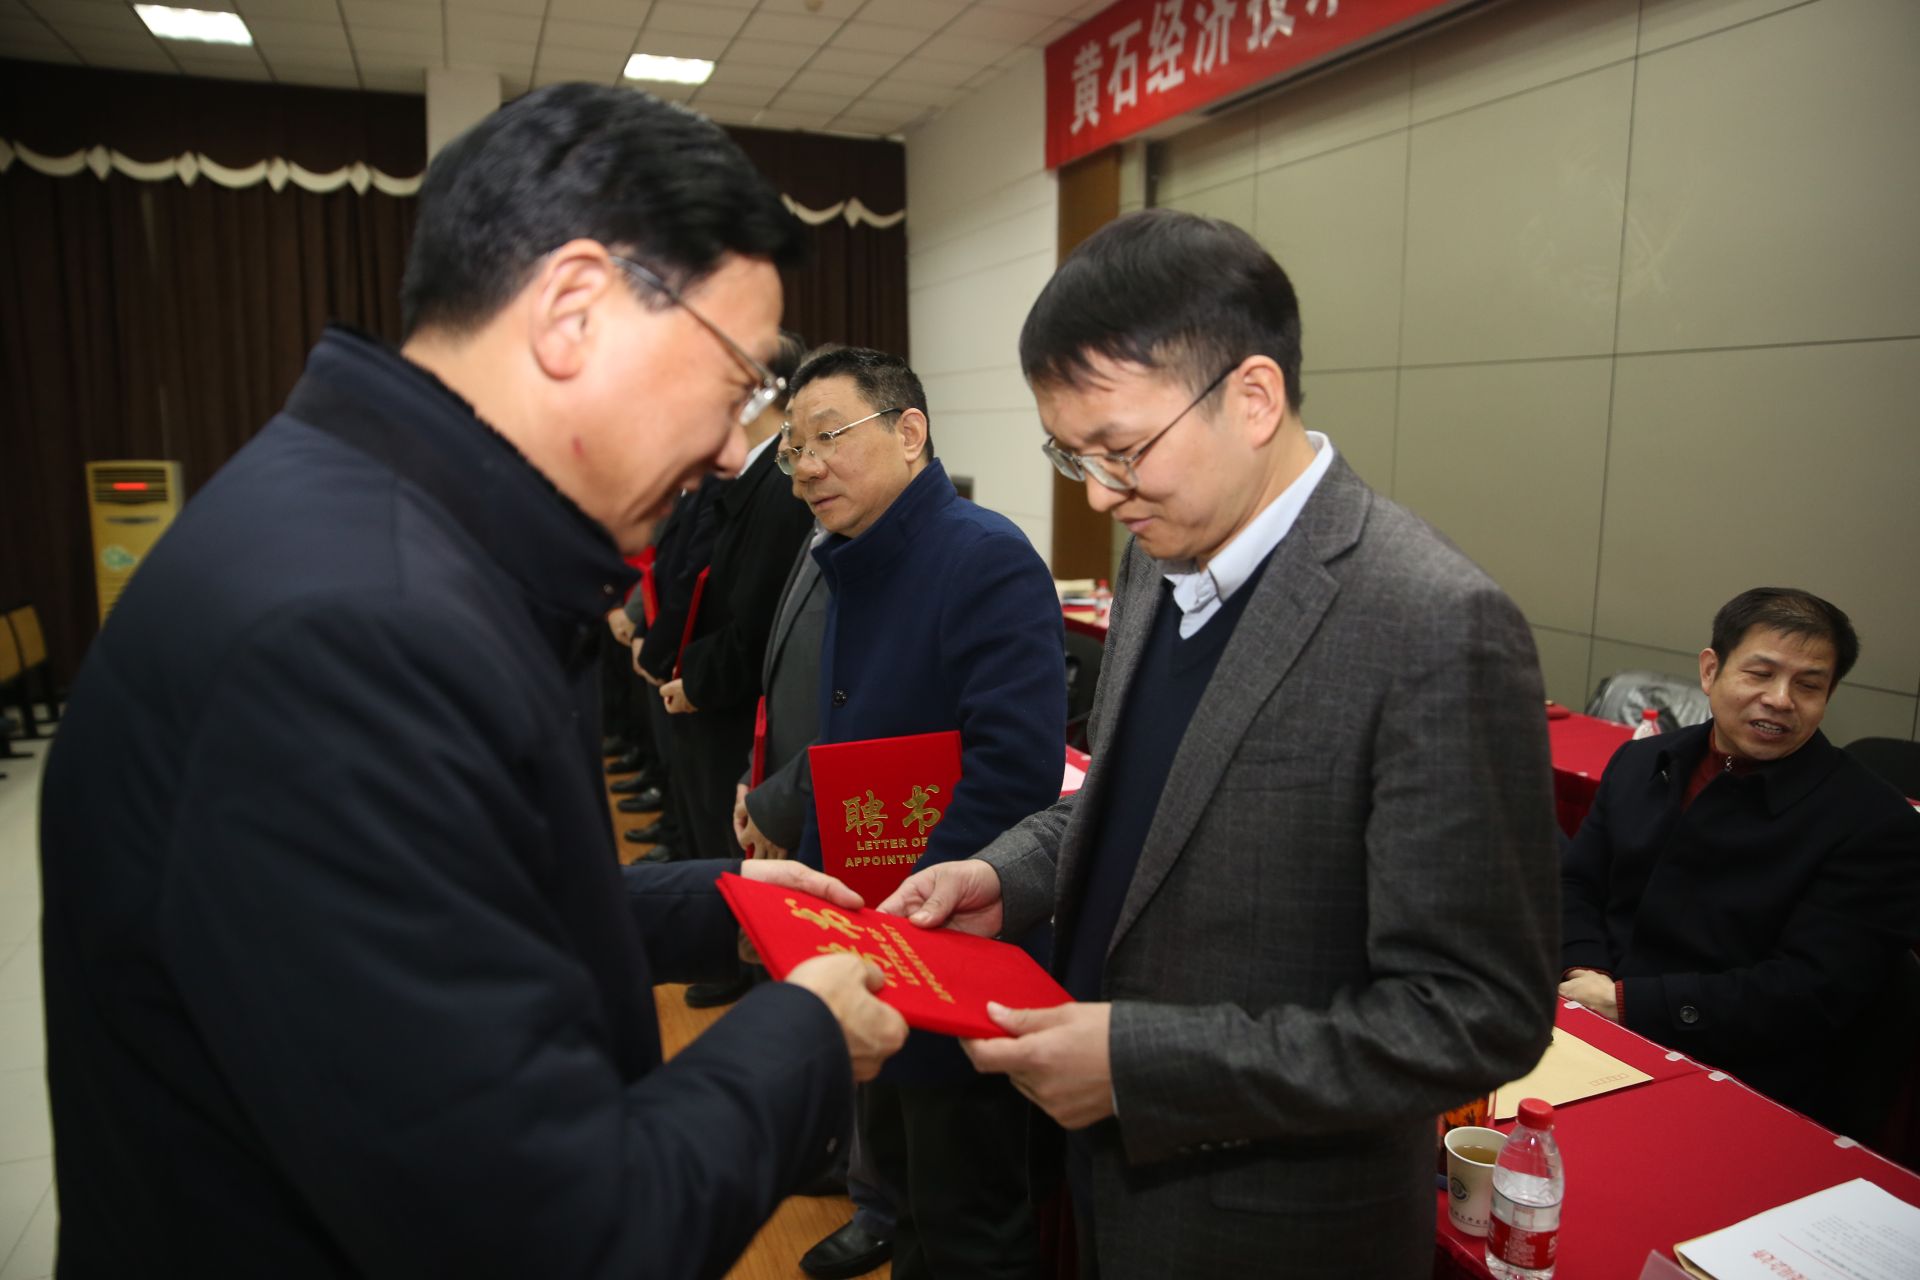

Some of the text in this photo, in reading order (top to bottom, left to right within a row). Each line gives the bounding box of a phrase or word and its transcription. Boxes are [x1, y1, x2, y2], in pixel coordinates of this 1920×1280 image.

[1070, 0, 1339, 135] 黄石经济技
[842, 784, 942, 838] 聘书
[845, 853, 923, 867] APPOINTM
[856, 836, 929, 851] LETTER OF
